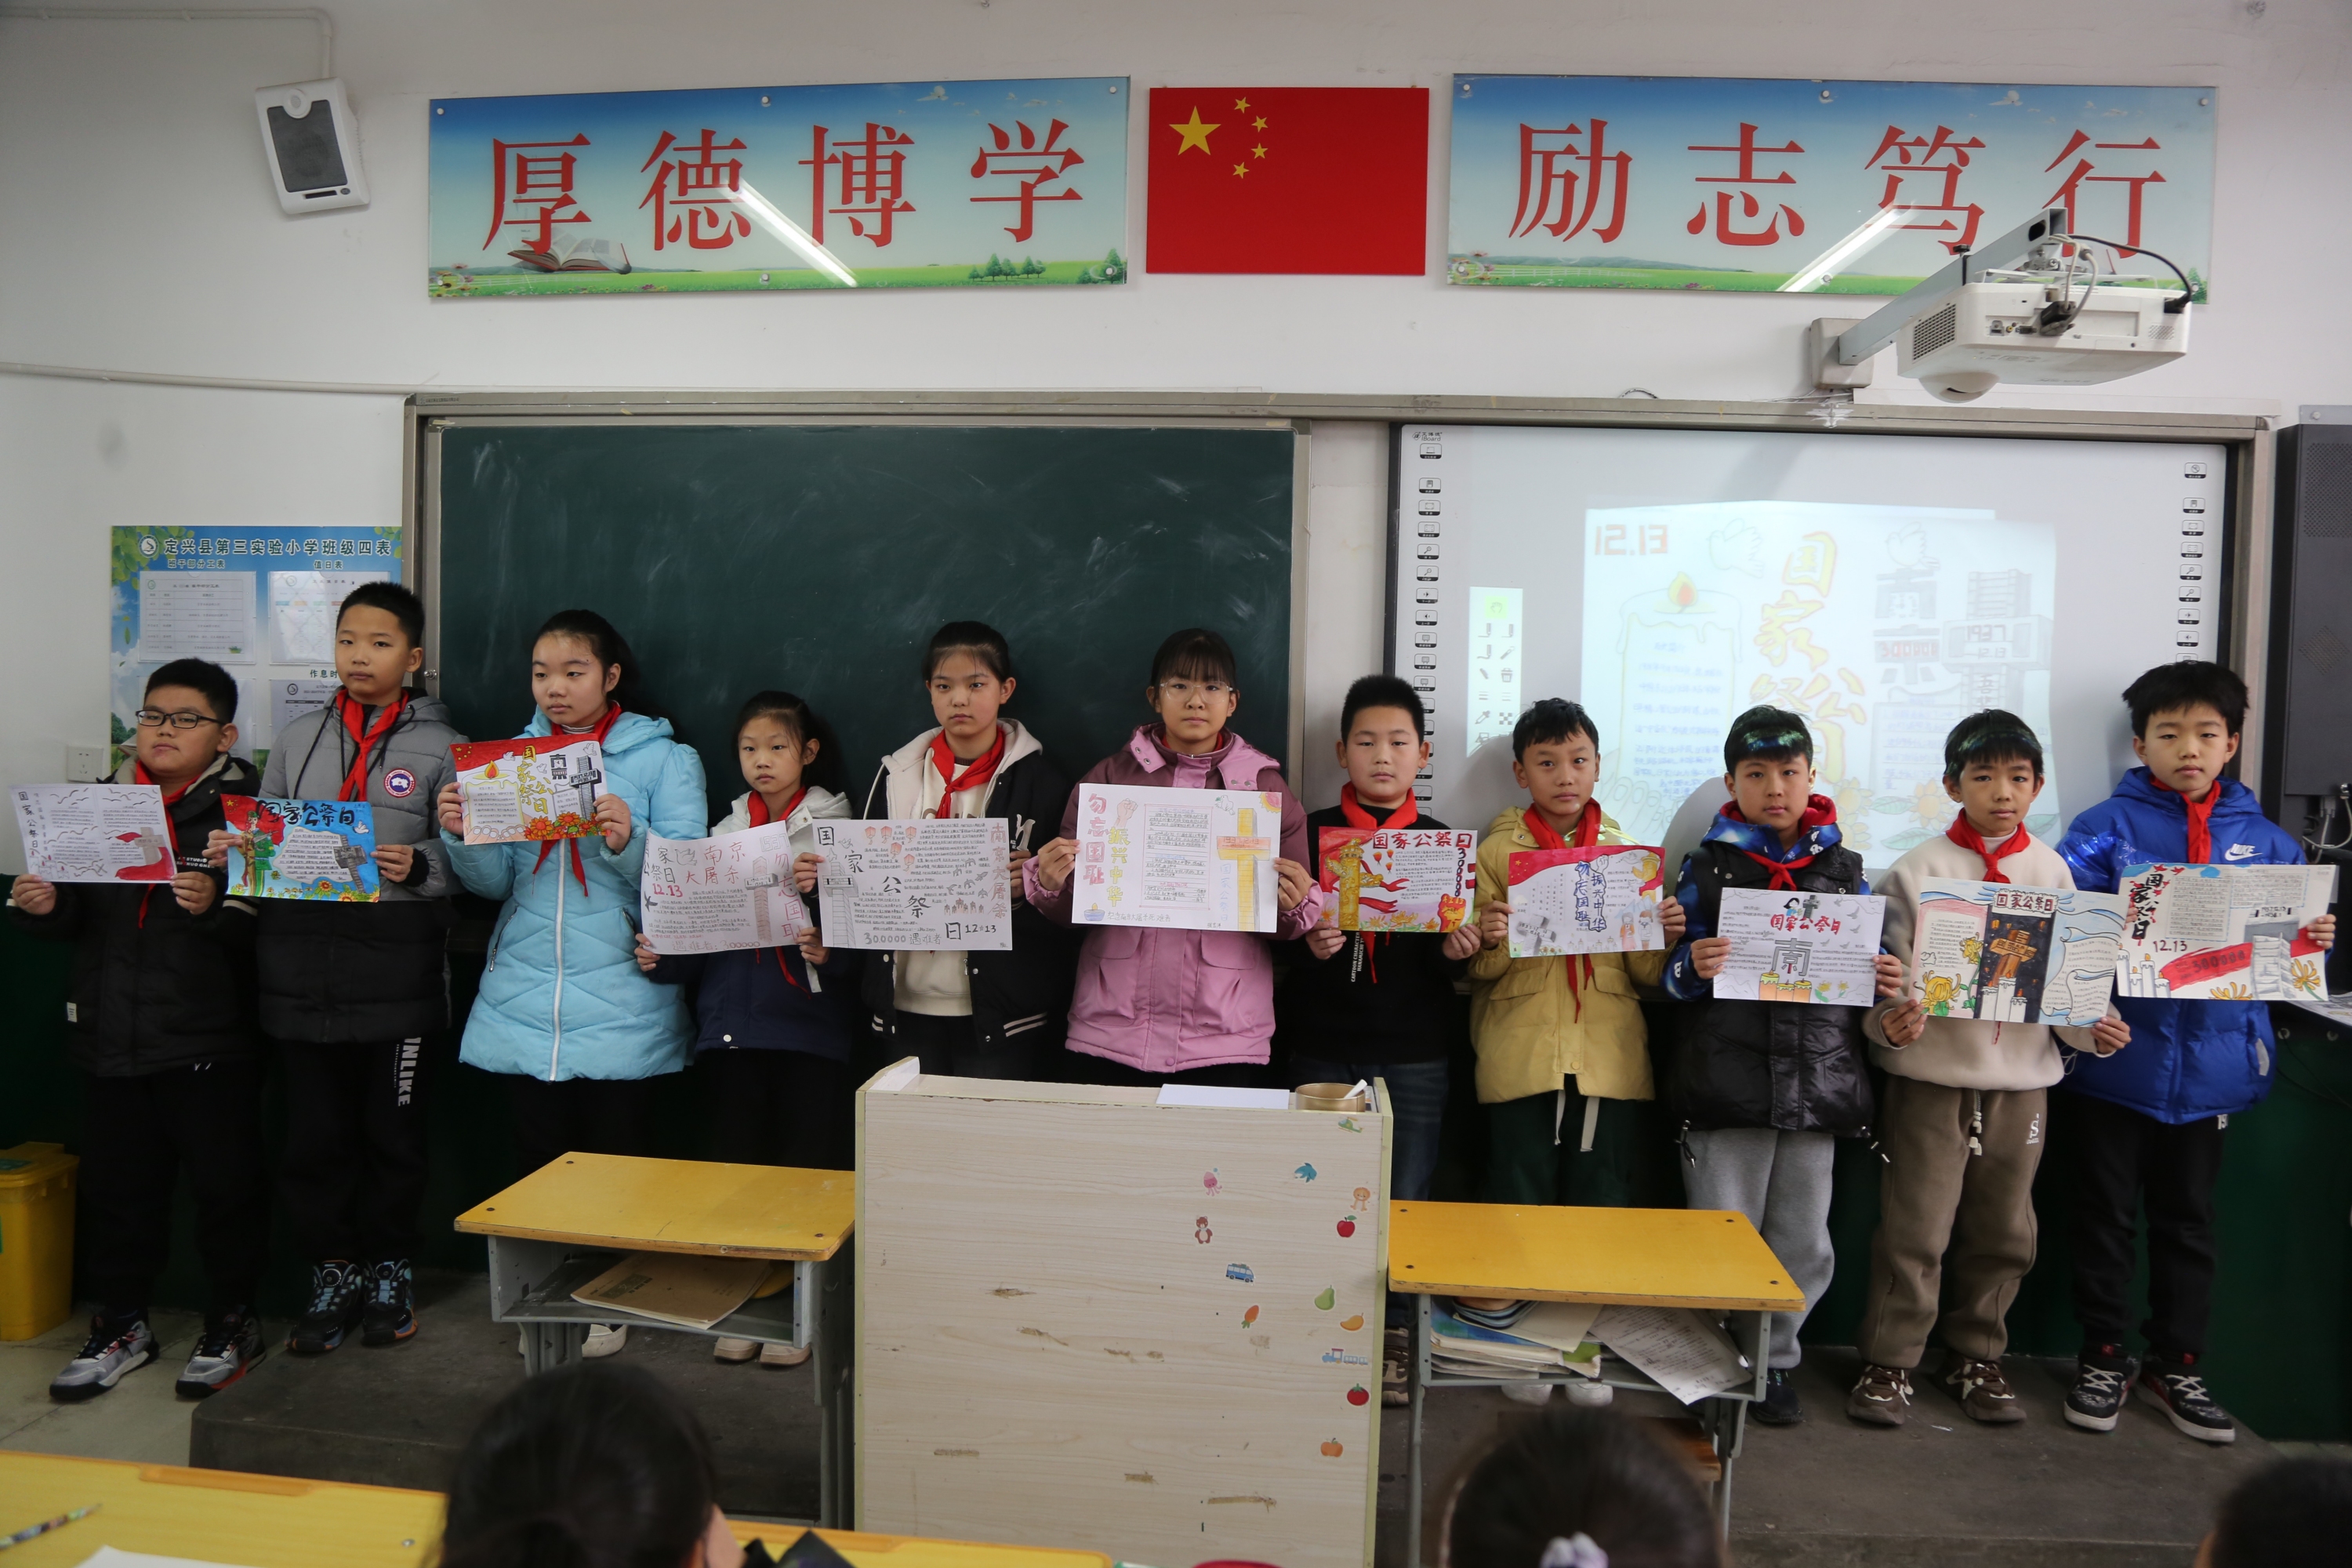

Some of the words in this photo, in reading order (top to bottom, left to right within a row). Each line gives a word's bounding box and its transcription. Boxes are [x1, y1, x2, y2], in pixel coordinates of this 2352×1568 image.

[483, 118, 1085, 254] 厚德博学
[1508, 118, 2166, 259] 励志笃行
[165, 539, 391, 556] 定兴县第三实验小学班级四表
[1594, 524, 1669, 556] 12.13
[168, 559, 226, 568] 班干部分工表
[314, 560, 343, 569] 值日表
[1967, 624, 2006, 642] 1937
[18, 791, 38, 848] 国家公祭日
[1083, 793, 1109, 886] 勿忘国耻
[1373, 831, 1472, 849] 国家公祭日
[2230, 843, 2256, 855] NIKE
[704, 841, 746, 866] 南京
[686, 865, 739, 886] 大屠杀
[989, 823, 1009, 920] 南京大屠杀
[1106, 827, 1131, 907] 振兴中华
[1454, 848, 1467, 897] 300000
[652, 883, 684, 898] 12.13
[1574, 862, 1592, 920] 勿忘国耻
[1590, 873, 1606, 932] 振兴中华
[1996, 893, 2054, 912] 国家公祭日
[1770, 913, 1842, 935] 国家公祭日
[2153, 939, 2188, 953] 12.13
[2191, 949, 2245, 973] 300000
